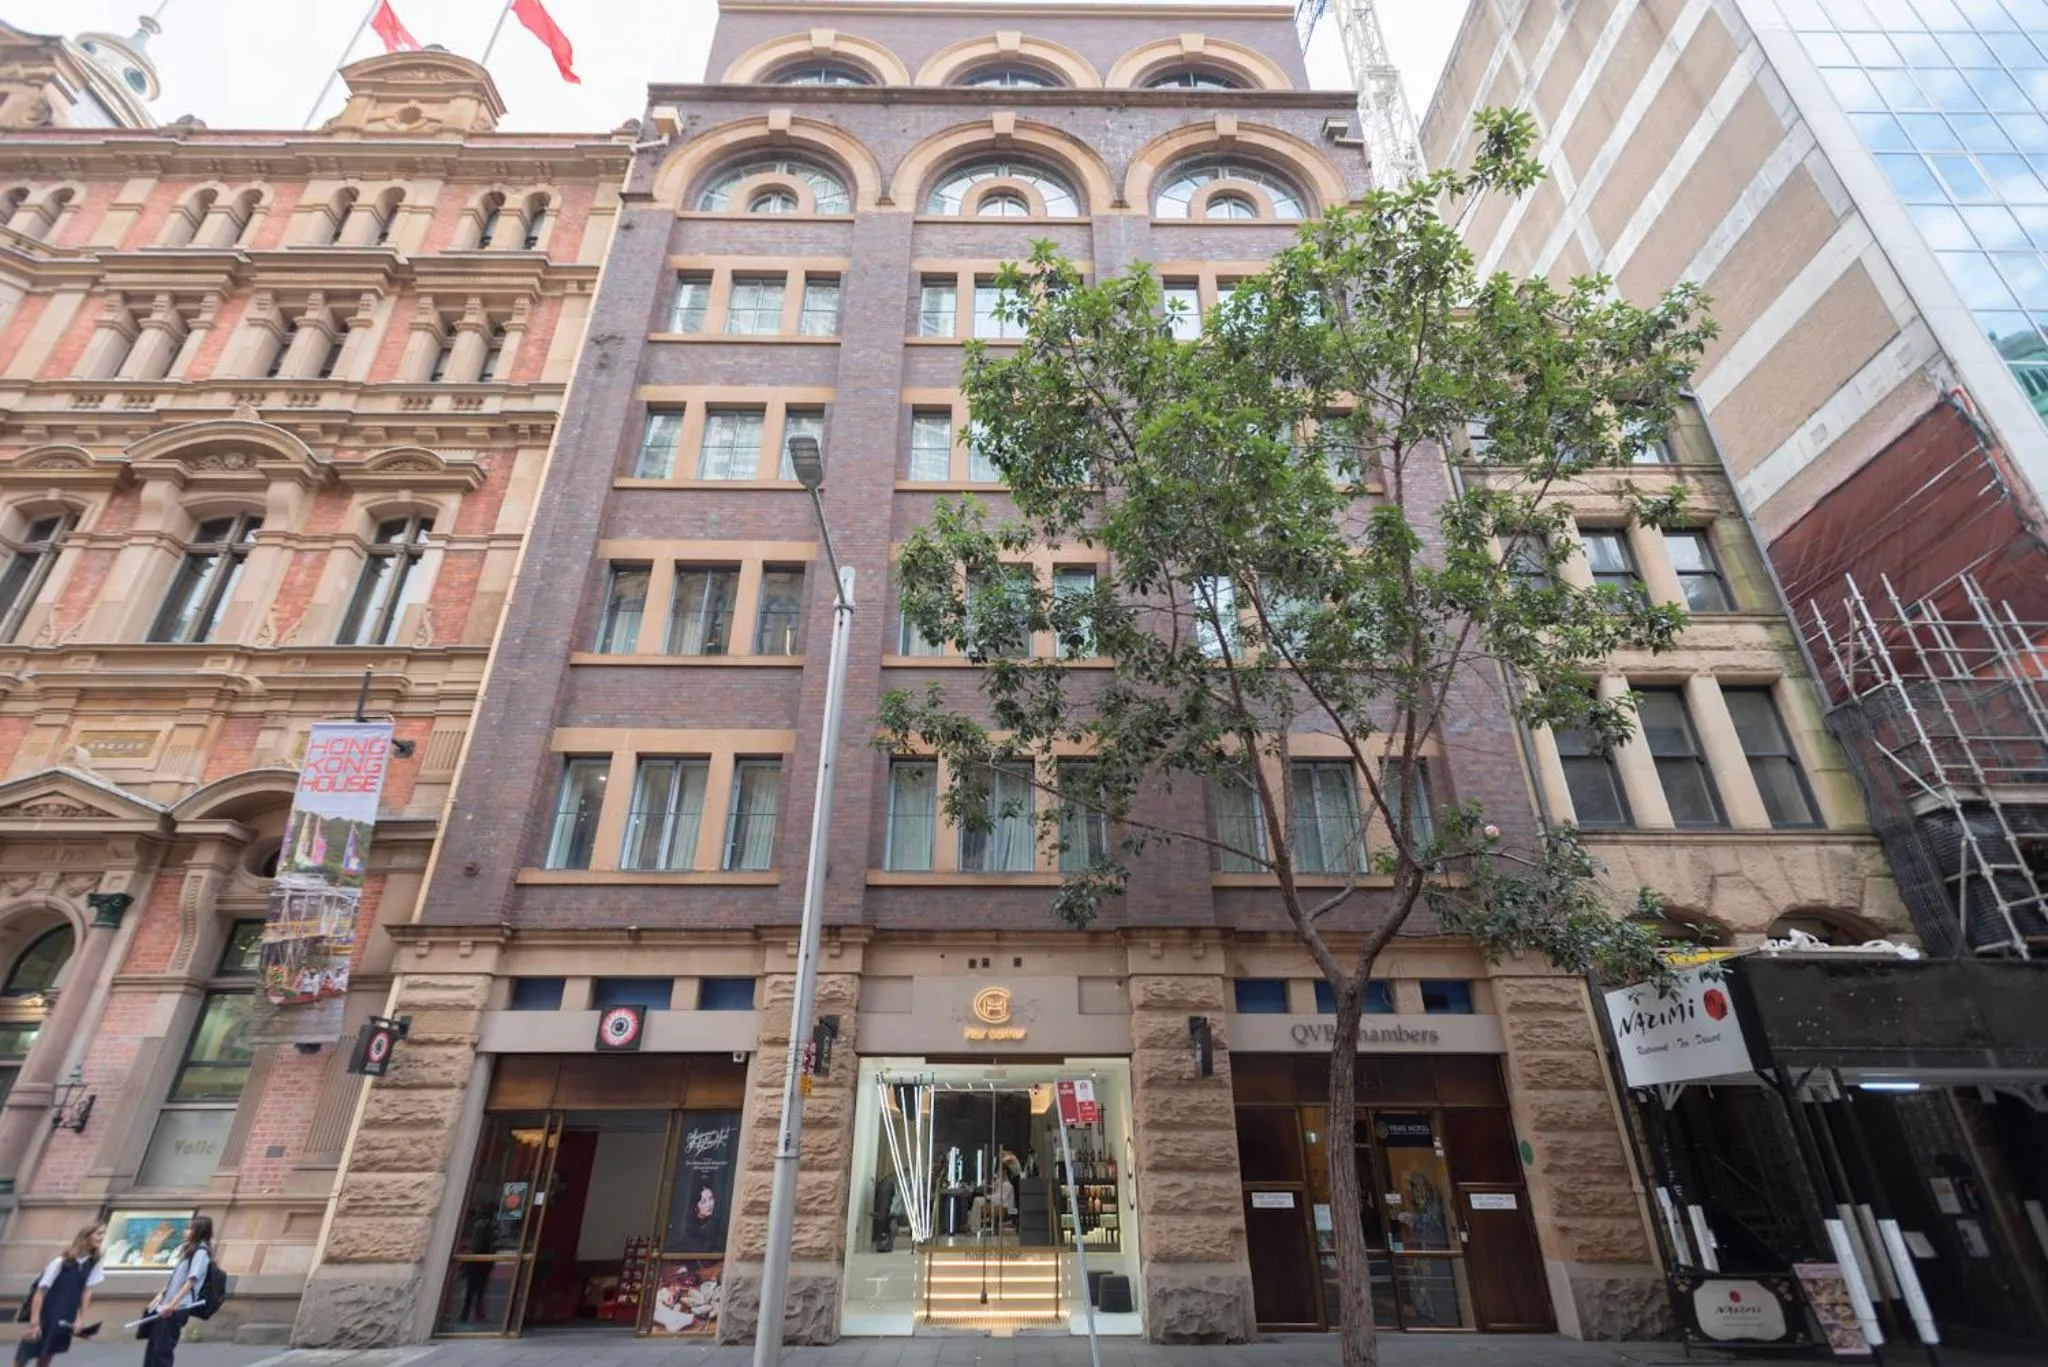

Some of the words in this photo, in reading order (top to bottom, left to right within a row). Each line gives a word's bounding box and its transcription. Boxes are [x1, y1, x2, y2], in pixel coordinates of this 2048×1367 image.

[308, 736, 386, 757] HONG
[303, 757, 383, 774] KONG
[299, 775, 379, 793] HOUSE
[1290, 1023, 1335, 1045] QVB
[1358, 1023, 1440, 1044] hambers
